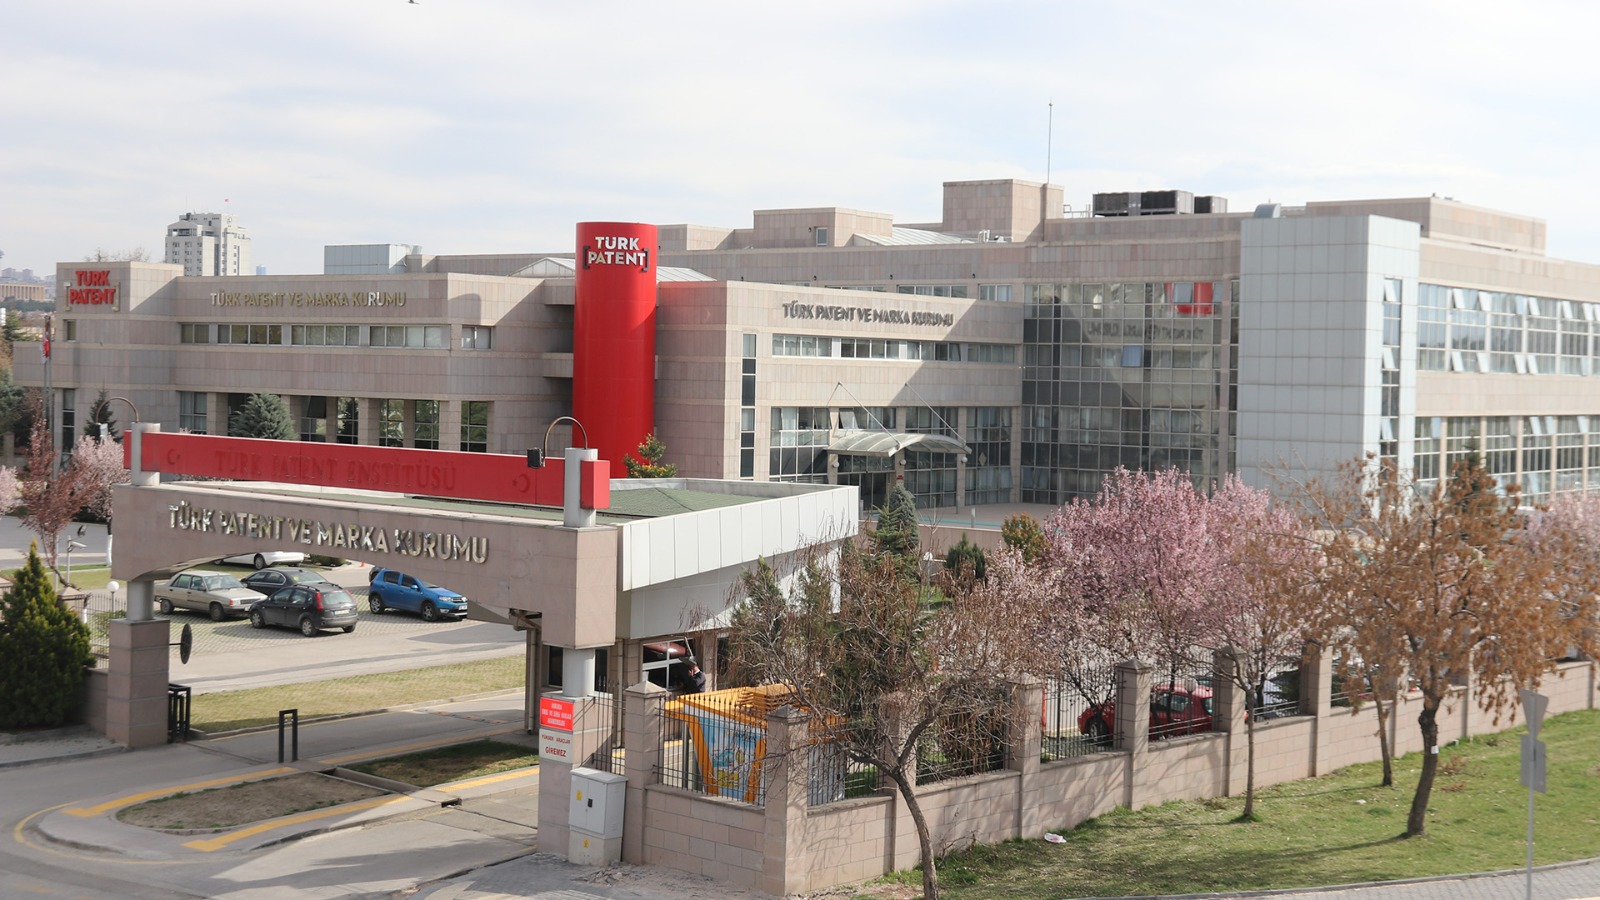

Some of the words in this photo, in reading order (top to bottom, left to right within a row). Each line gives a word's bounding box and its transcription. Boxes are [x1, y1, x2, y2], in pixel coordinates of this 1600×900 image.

[210, 290, 241, 307] TÜRK
[244, 292, 285, 307] PATENT
[288, 292, 303, 307] VE
[306, 292, 348, 307] MARKA
[352, 291, 406, 307] KURUMU
[782, 300, 814, 319] TÜRK
[815, 303, 857, 321] PATENT
[857, 307, 872, 322] VE
[873, 308, 910, 325] MARKA
[911, 311, 954, 327] KURUMU
[168, 500, 215, 532] TÜRK
[219, 510, 285, 540] PATENT
[287, 518, 313, 545] VE
[316, 521, 389, 553] MARKA
[394, 528, 490, 564] KURUMU
